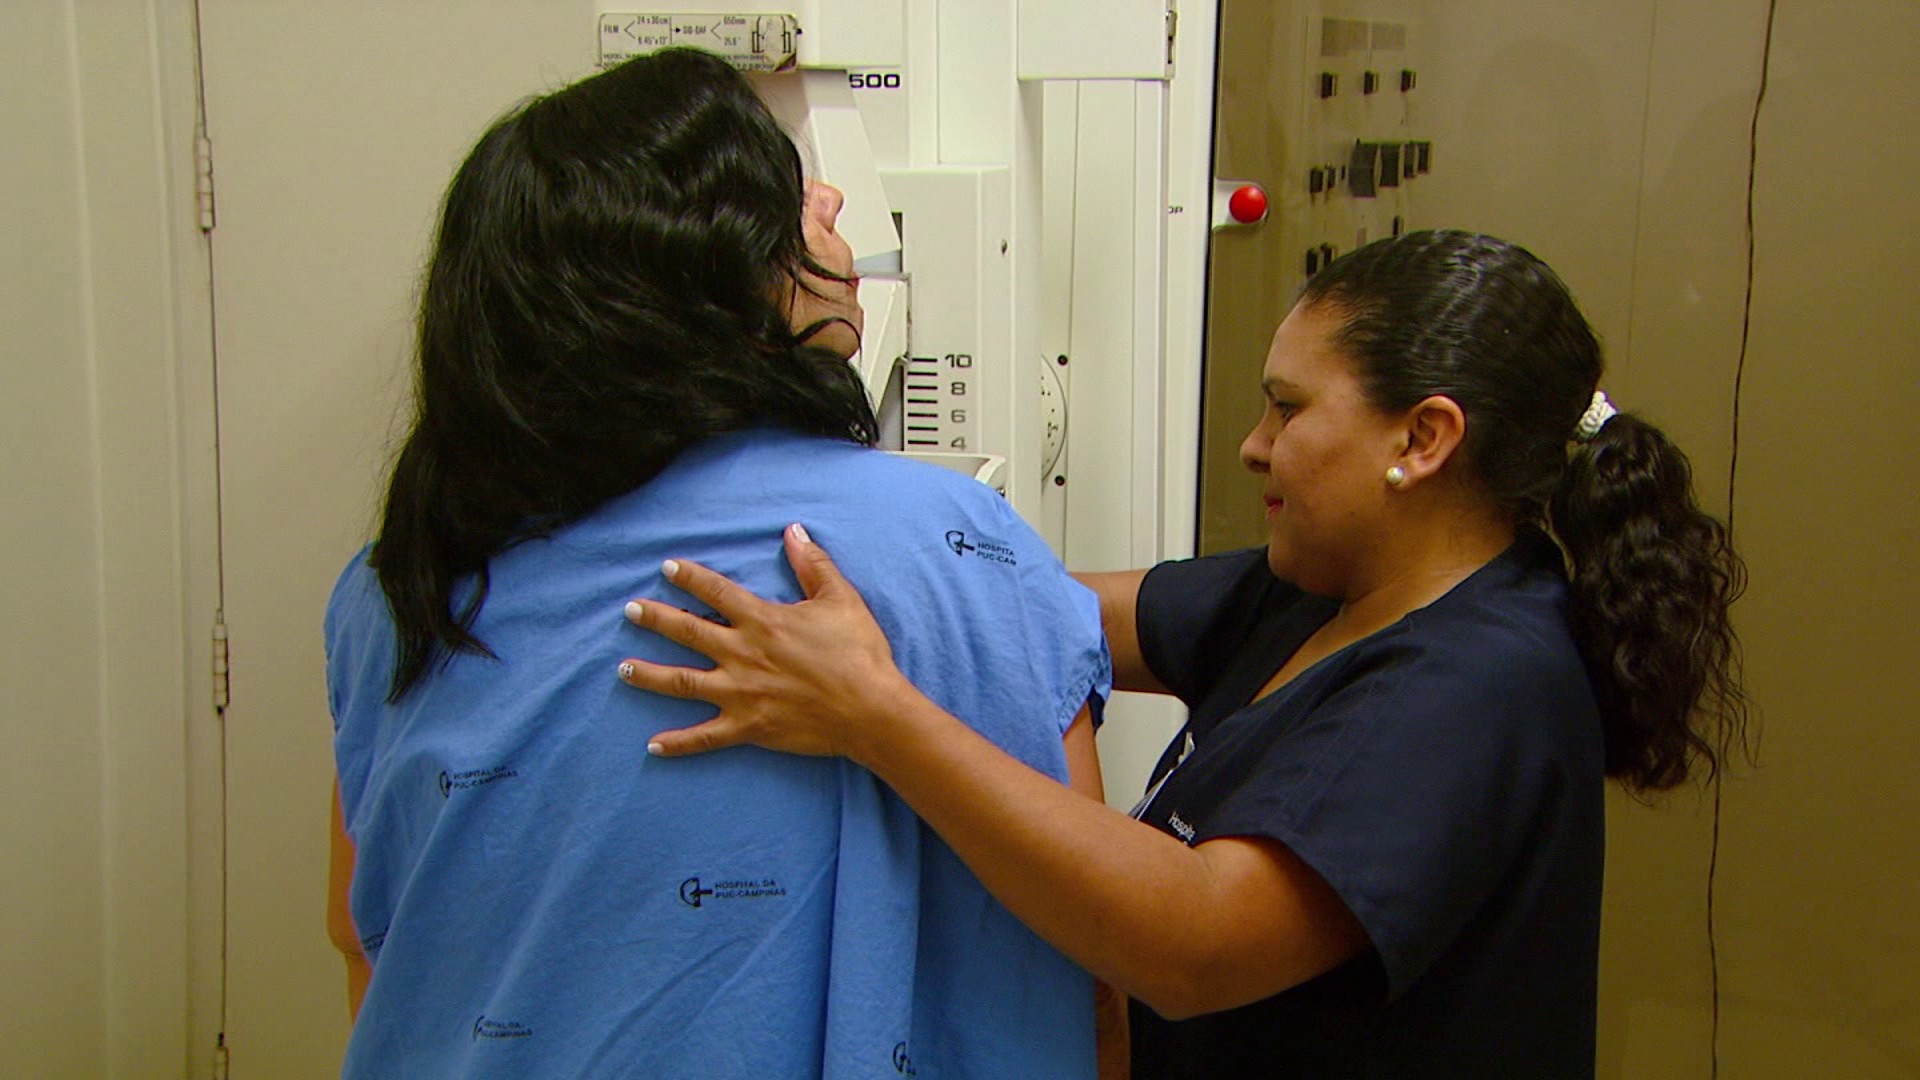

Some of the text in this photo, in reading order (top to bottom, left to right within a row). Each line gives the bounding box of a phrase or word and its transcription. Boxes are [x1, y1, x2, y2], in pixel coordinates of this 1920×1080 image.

[849, 74, 900, 88] 500
[945, 354, 972, 368] 10
[951, 382, 966, 396] 8
[951, 409, 966, 423] 6
[951, 437, 967, 450] 4
[715, 879, 777, 889] HOSPITAL DA
